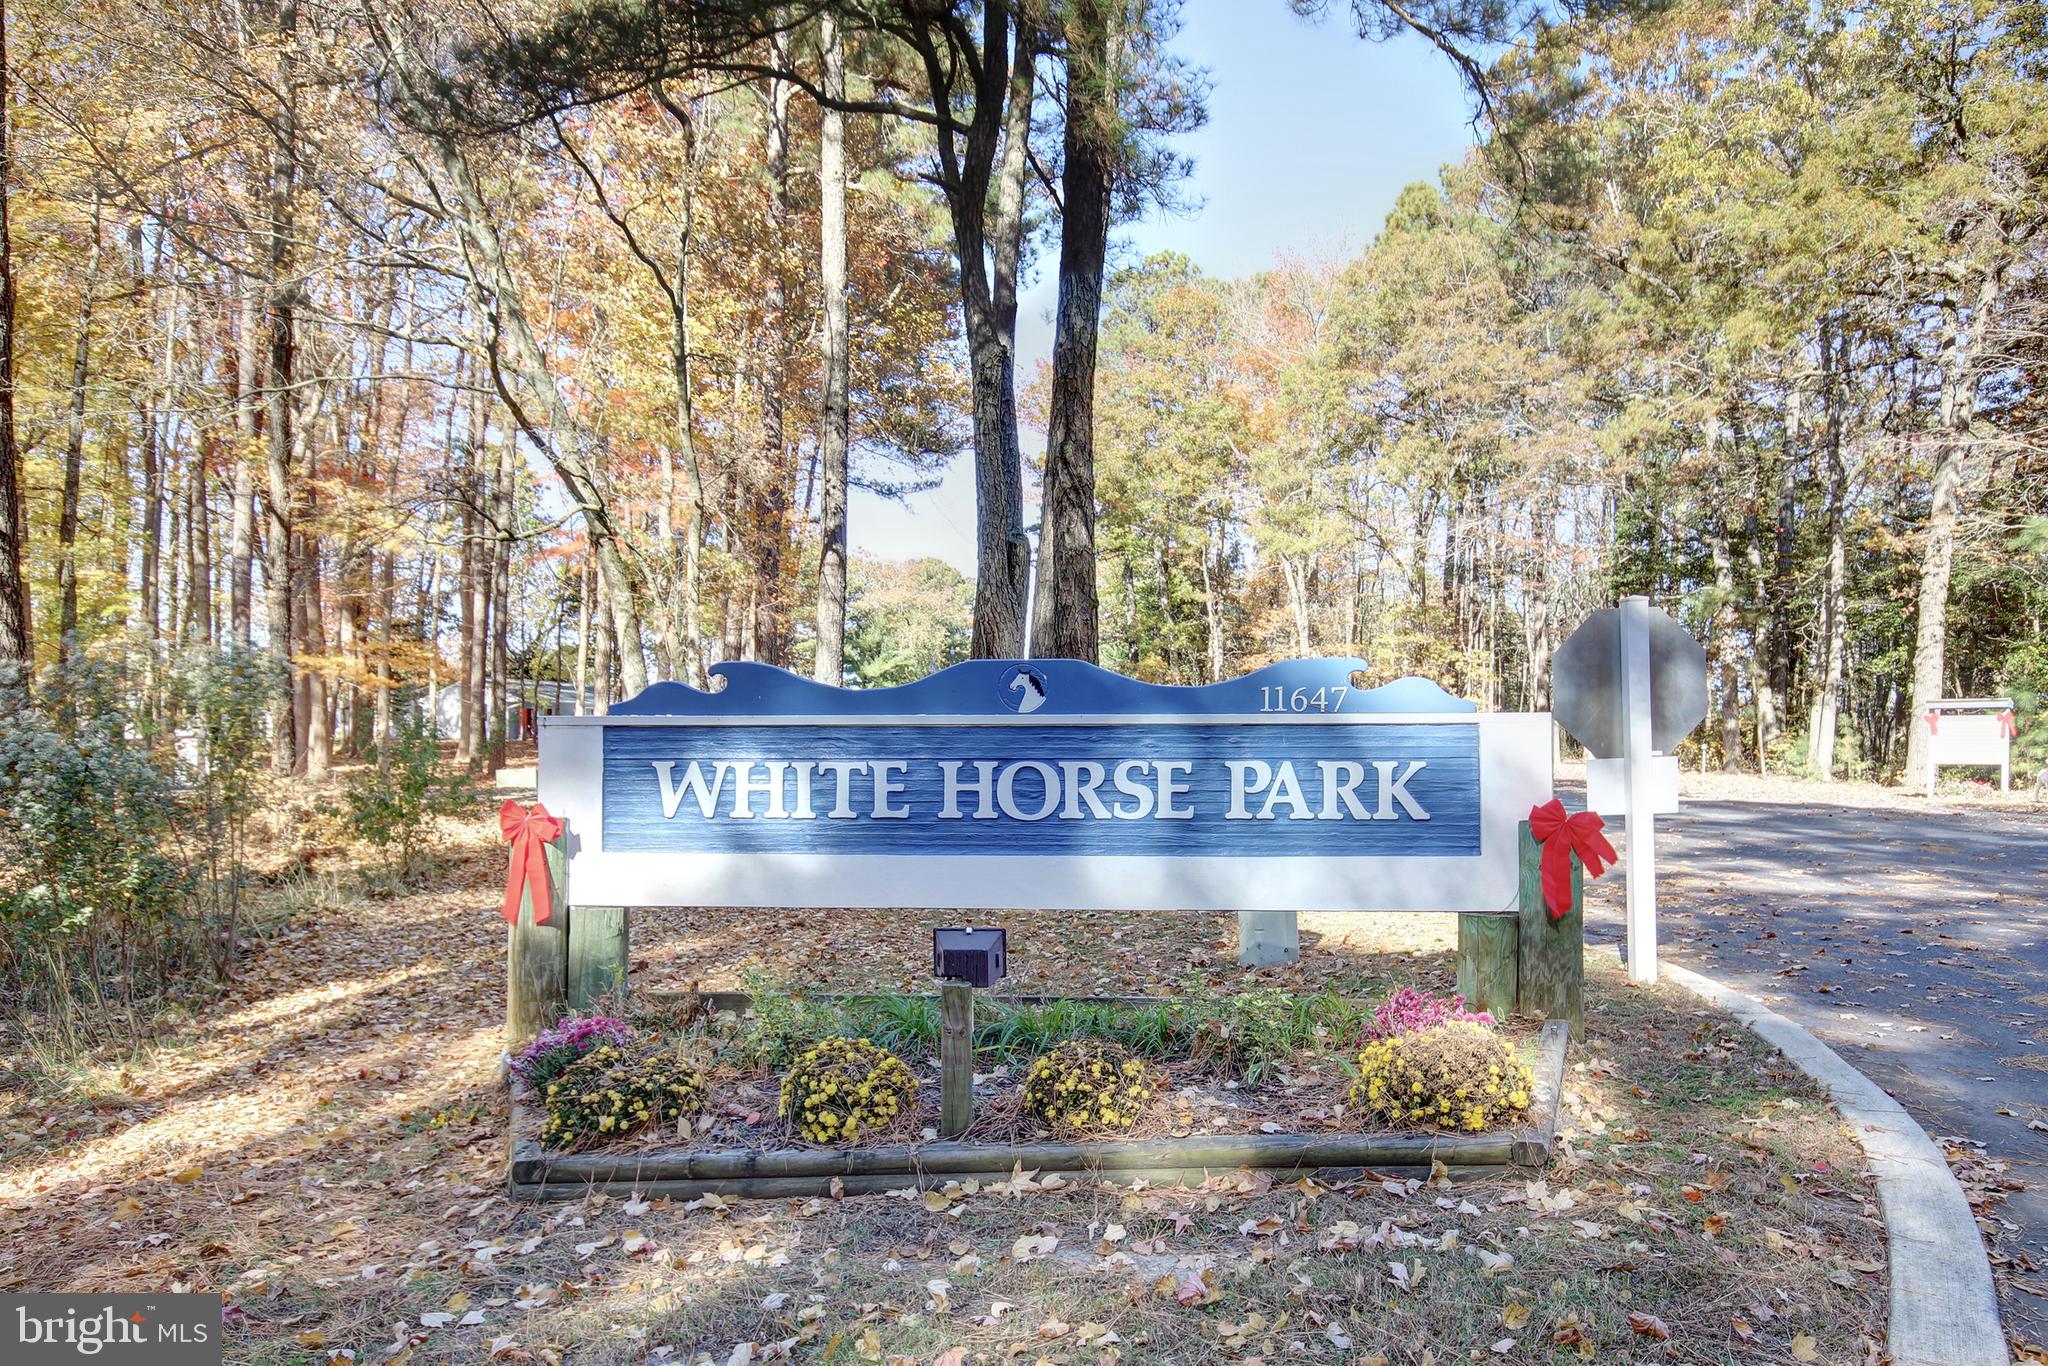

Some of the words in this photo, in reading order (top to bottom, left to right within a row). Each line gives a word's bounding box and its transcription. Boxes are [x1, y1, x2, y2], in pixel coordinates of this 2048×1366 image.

[1260, 686, 1349, 713] 11647
[651, 760, 910, 820] WHITE
[937, 760, 1196, 821] HORSE
[1225, 760, 1432, 822] PARK
